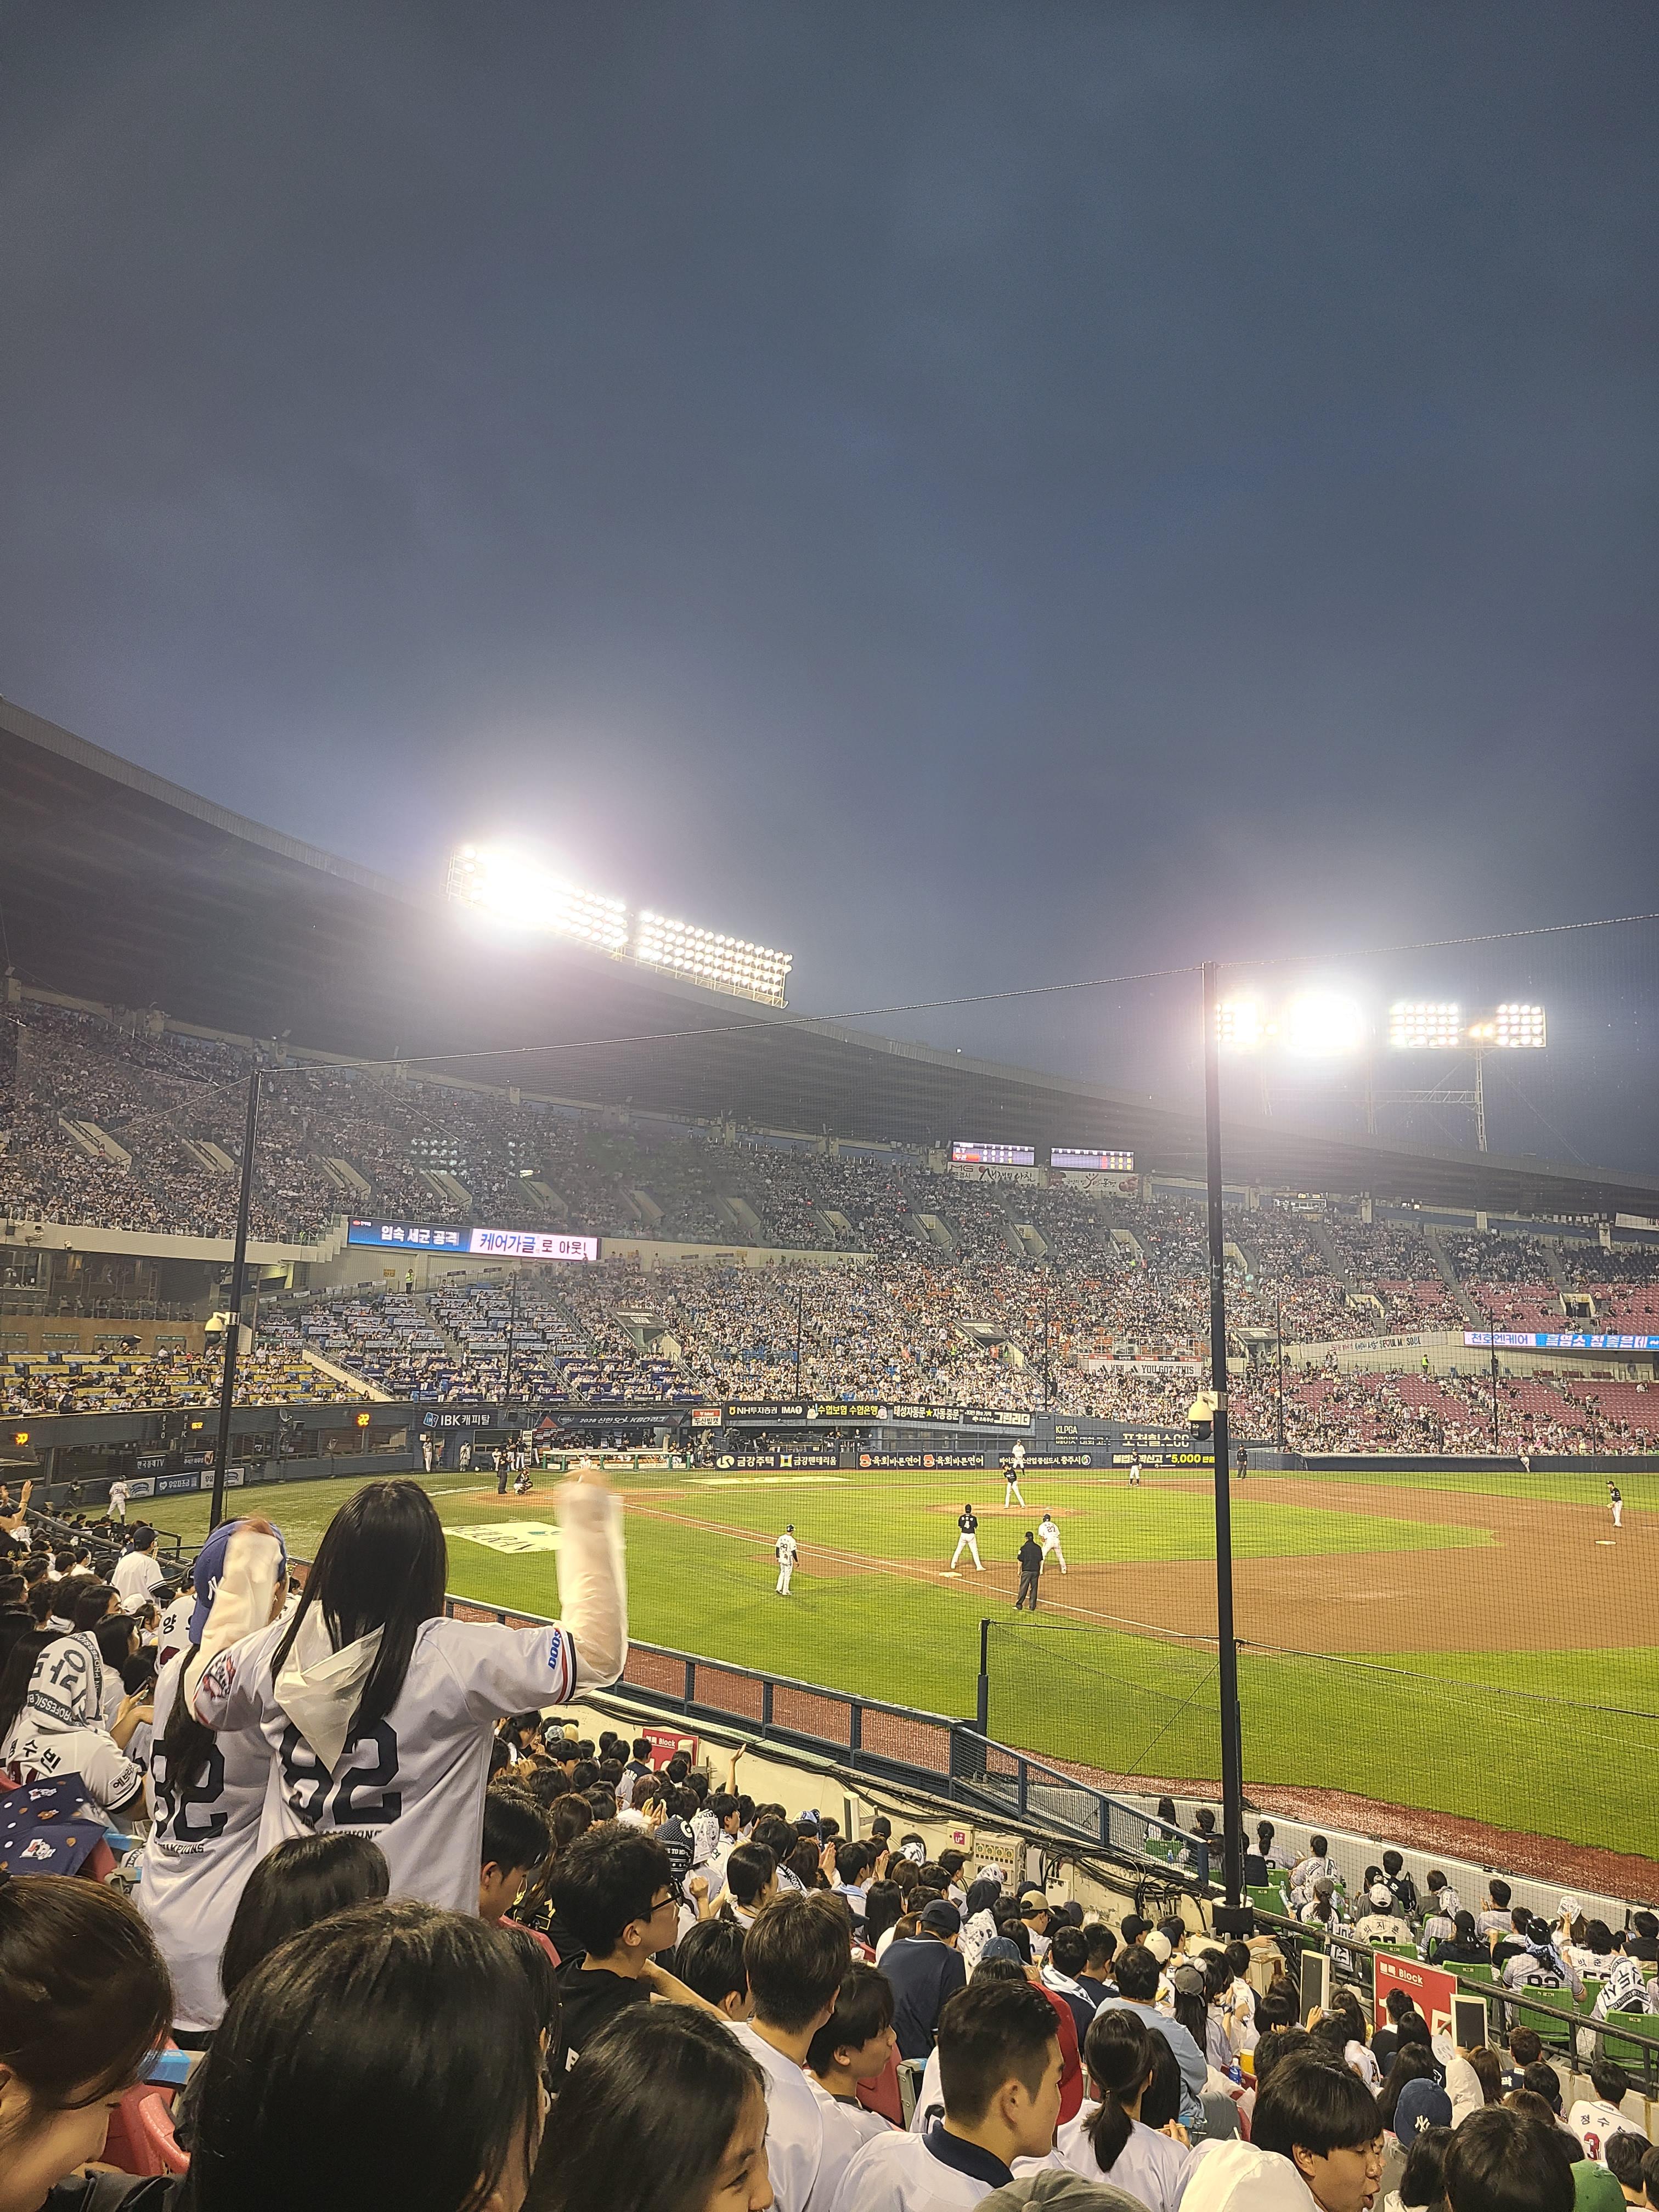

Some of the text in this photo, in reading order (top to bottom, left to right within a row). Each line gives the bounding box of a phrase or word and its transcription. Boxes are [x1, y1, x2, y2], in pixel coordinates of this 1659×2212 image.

[381, 1226, 460, 1246] 입속 세균 공격
[479, 1233, 535, 1254] 케어가글
[542, 1239, 552, 1252] 로
[1407, 1336, 1421, 1346] SOUL
[1471, 1333, 1528, 1344] 천호엔케어
[1546, 1334, 1586, 1347] 흑염소
[1141, 1365, 1194, 1374] YOU GOT THIS
[737, 1407, 777, 1415] NH투자증권
[818, 1405, 878, 1415] 수협보험 수협은행
[893, 1405, 926, 1418] 태성자동문
[441, 1414, 490, 1426] IBK캐피탈
[994, 1412, 1030, 1425] 그린리더
[1056, 1425, 1077, 1434] KLPGA
[137, 1459, 165, 1469] 한국경제TV
[737, 1456, 775, 1467] 금강주택
[793, 1456, 837, 1466] 금강펜테리움
[872, 1455, 921, 1466] 육회바른연어
[935, 1455, 984, 1466] 육회바른연어
[1060, 1455, 1081, 1465] 충주시
[1113, 1454, 1163, 1464] 불법박신고
[1171, 1454, 1201, 1464] 5,000
[168, 1479, 190, 1488] 우유자조금
[964, 1520, 969, 1528] 4
[548, 1631, 561, 1669] DOOS
[659, 1737, 675, 1747] Block
[1398, 1968, 1423, 1984] Block
